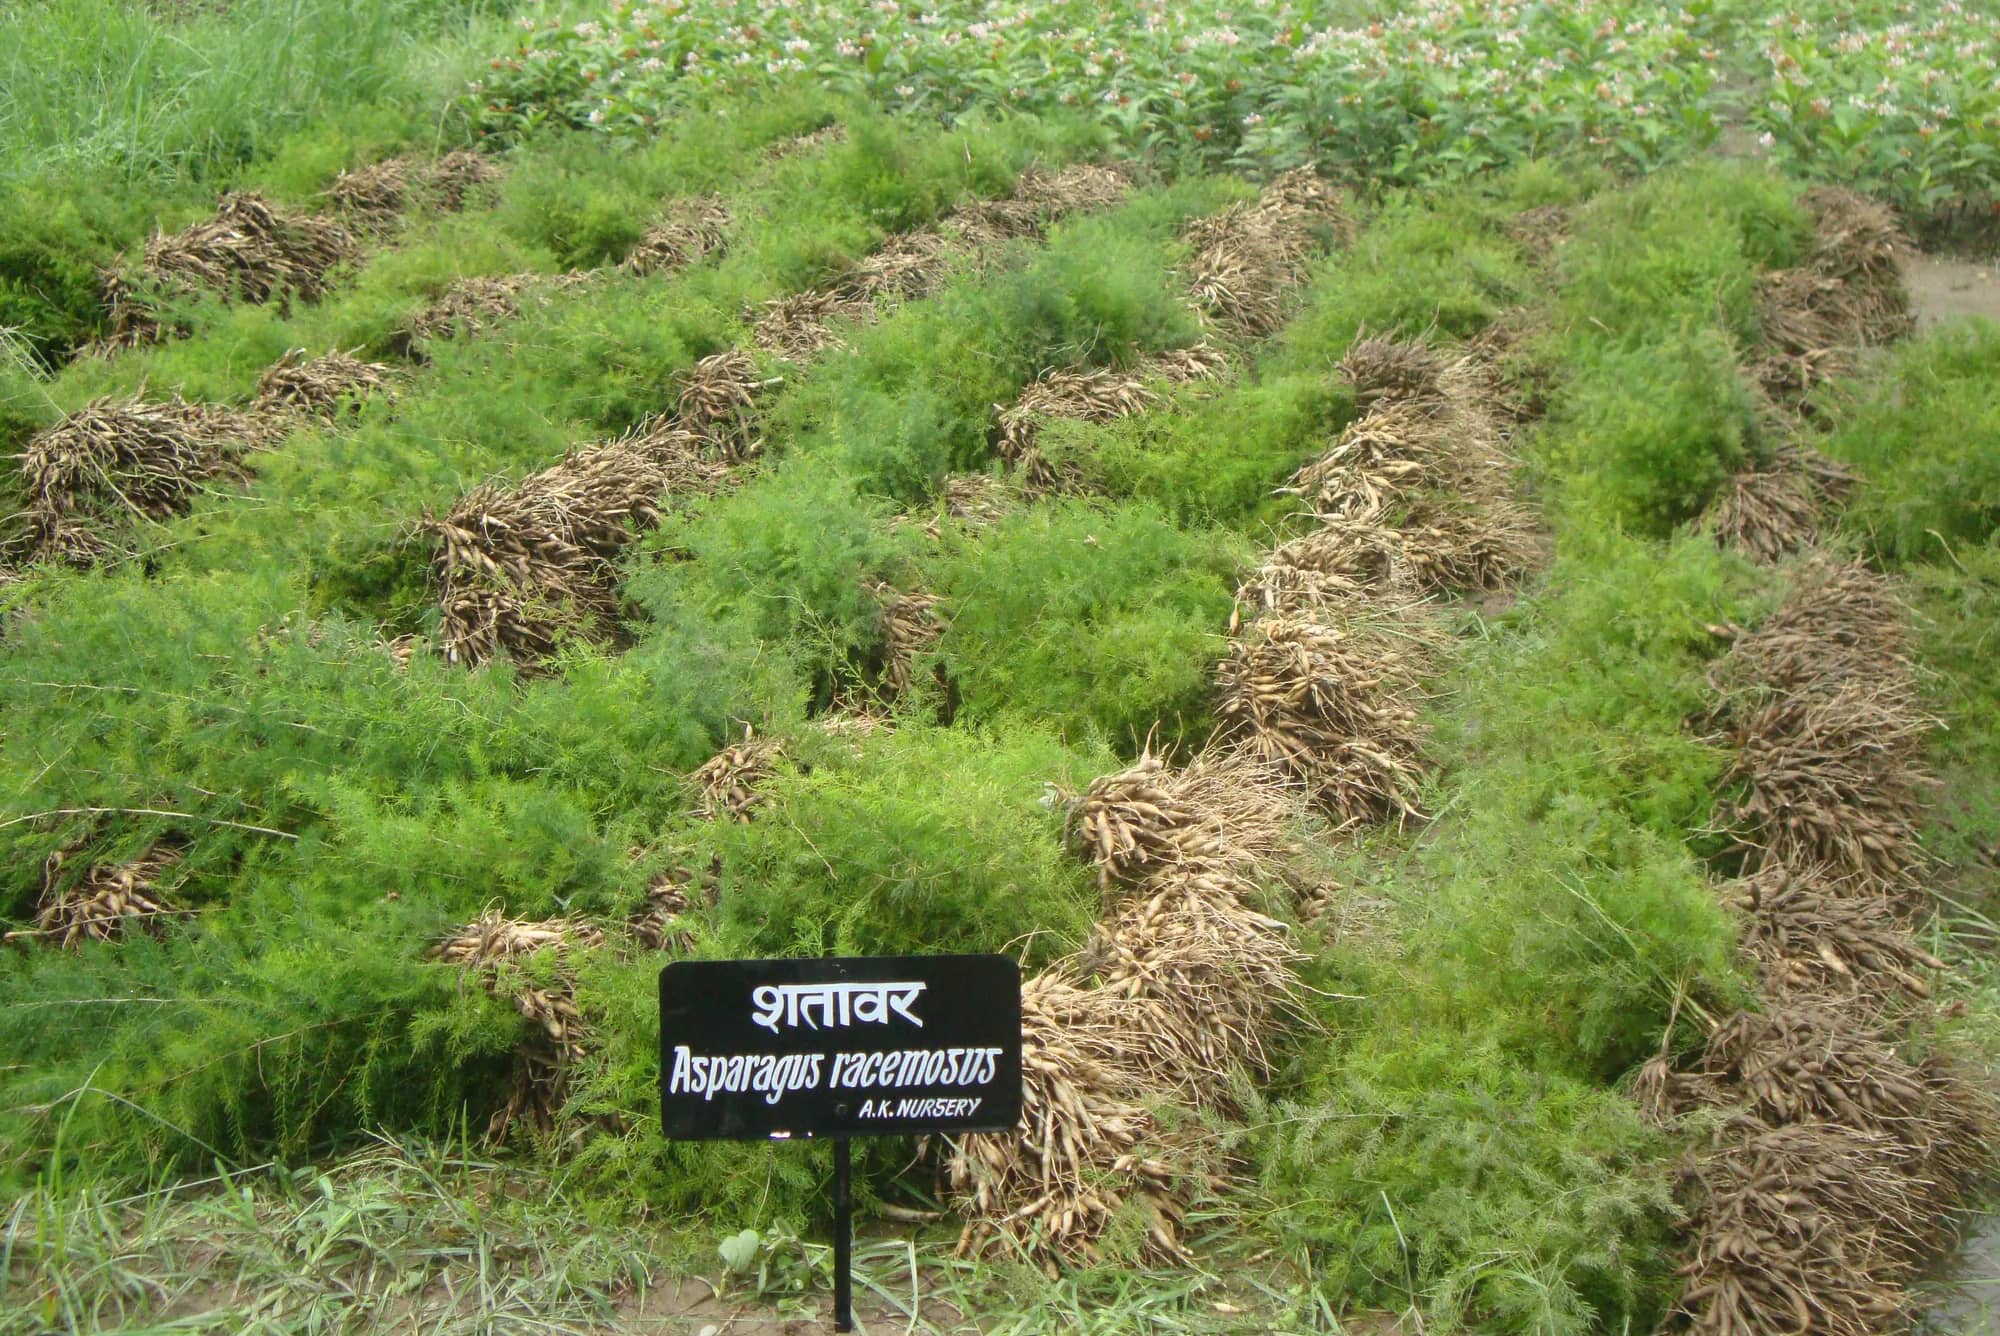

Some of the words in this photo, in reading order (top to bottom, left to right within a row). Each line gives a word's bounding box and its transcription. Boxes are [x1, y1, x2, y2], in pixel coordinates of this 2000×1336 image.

[752, 982, 927, 1034] शतावर
[670, 1046, 824, 1104] Asparagus
[830, 1048, 1003, 1088] racemosus
